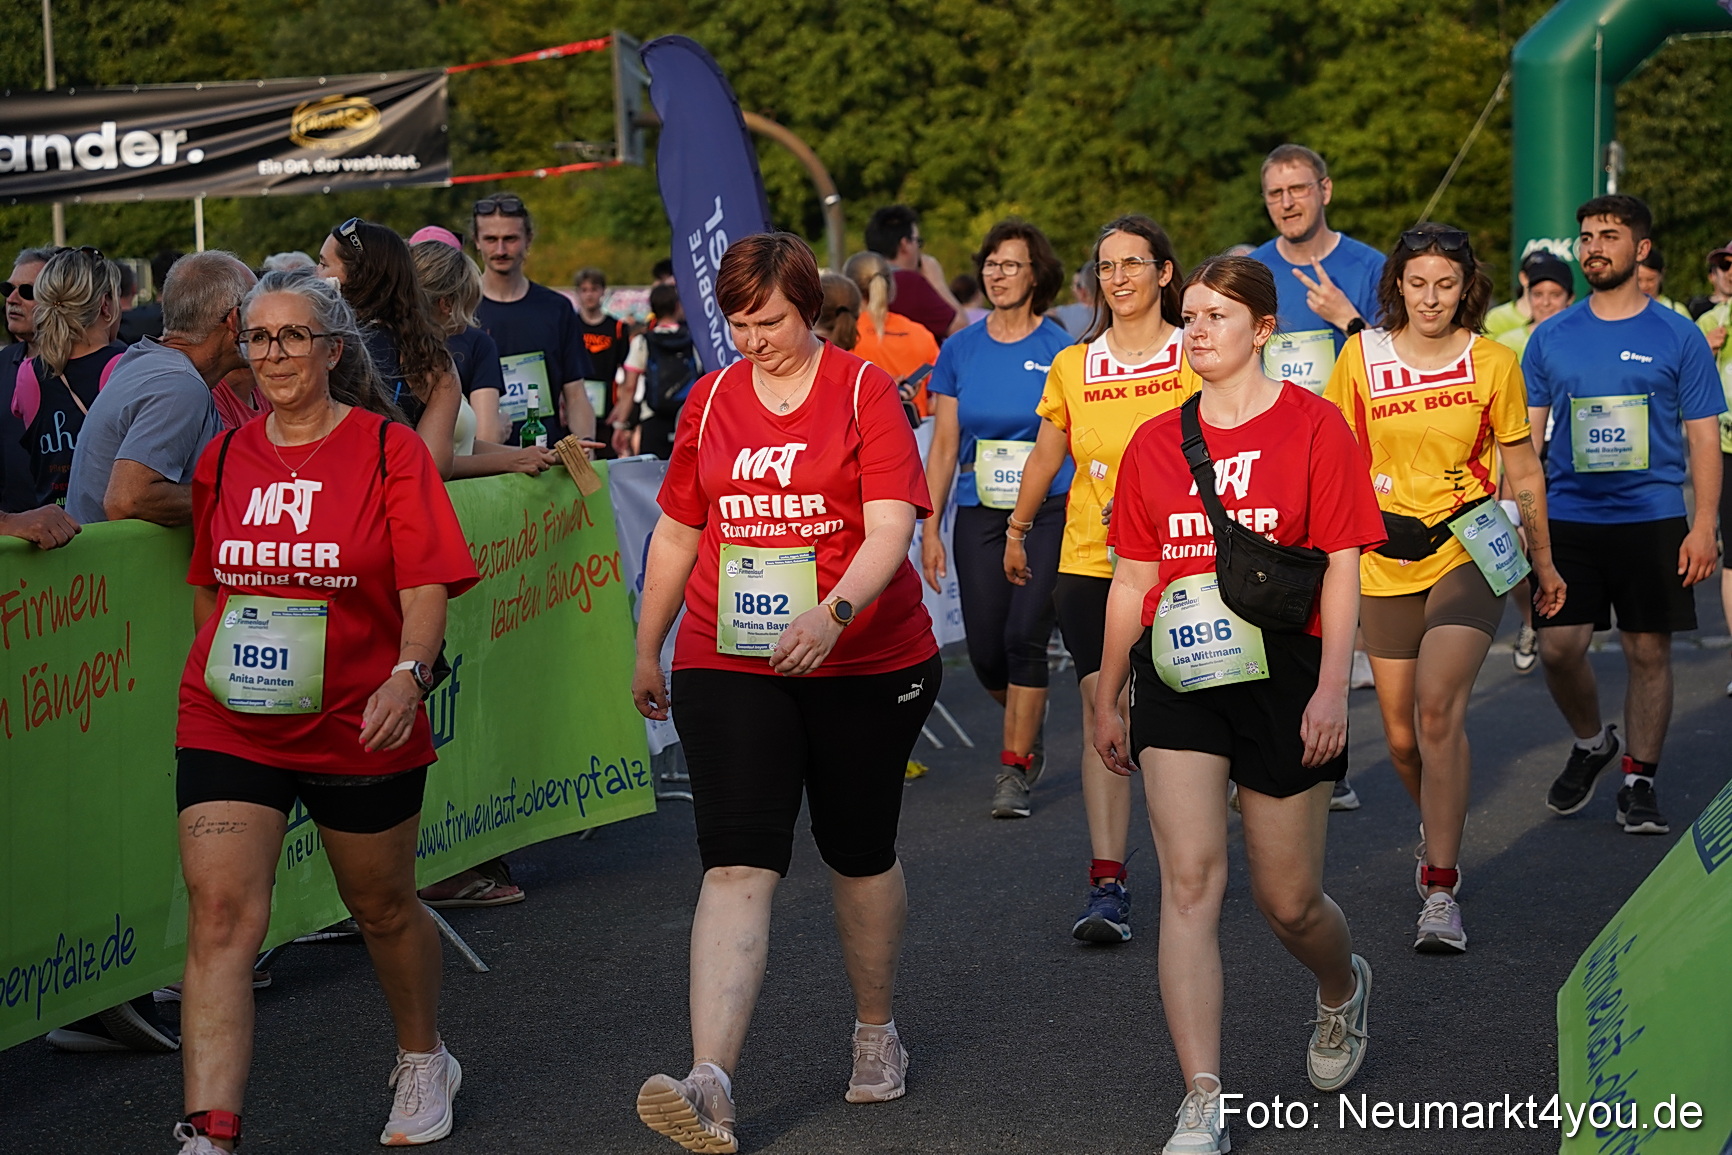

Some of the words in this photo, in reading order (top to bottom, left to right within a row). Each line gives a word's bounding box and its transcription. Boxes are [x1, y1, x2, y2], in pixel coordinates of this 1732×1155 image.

[257, 159, 283, 175] Ein
[1281, 362, 1313, 378] 947
[1084, 386, 1128, 403] MAX
[1135, 377, 1183, 397] BÖGL
[1371, 399, 1418, 421] MAX
[1425, 390, 1480, 411] BÖGL
[1589, 427, 1626, 444] 962
[731, 442, 808, 488] MRT
[242, 478, 323, 535] MRT
[718, 493, 827, 519] MEIER
[720, 521, 787, 538] Running
[788, 518, 844, 538] Team
[218, 539, 340, 568] MEIER
[213, 567, 290, 587] Running
[293, 571, 358, 588] Team
[0, 573, 108, 650] Firmen
[491, 574, 541, 641] laufen
[734, 591, 790, 616] 1882
[732, 619, 764, 630] Martina
[1168, 618, 1232, 650] 1896
[233, 643, 288, 671] 1891
[1172, 655, 1191, 666] Lisa
[1191, 647, 1242, 661] Wittmann
[22, 620, 136, 733] länger!
[228, 672, 255, 685] Anita
[256, 675, 294, 687] Panten
[897, 688, 920, 704] PUMA
